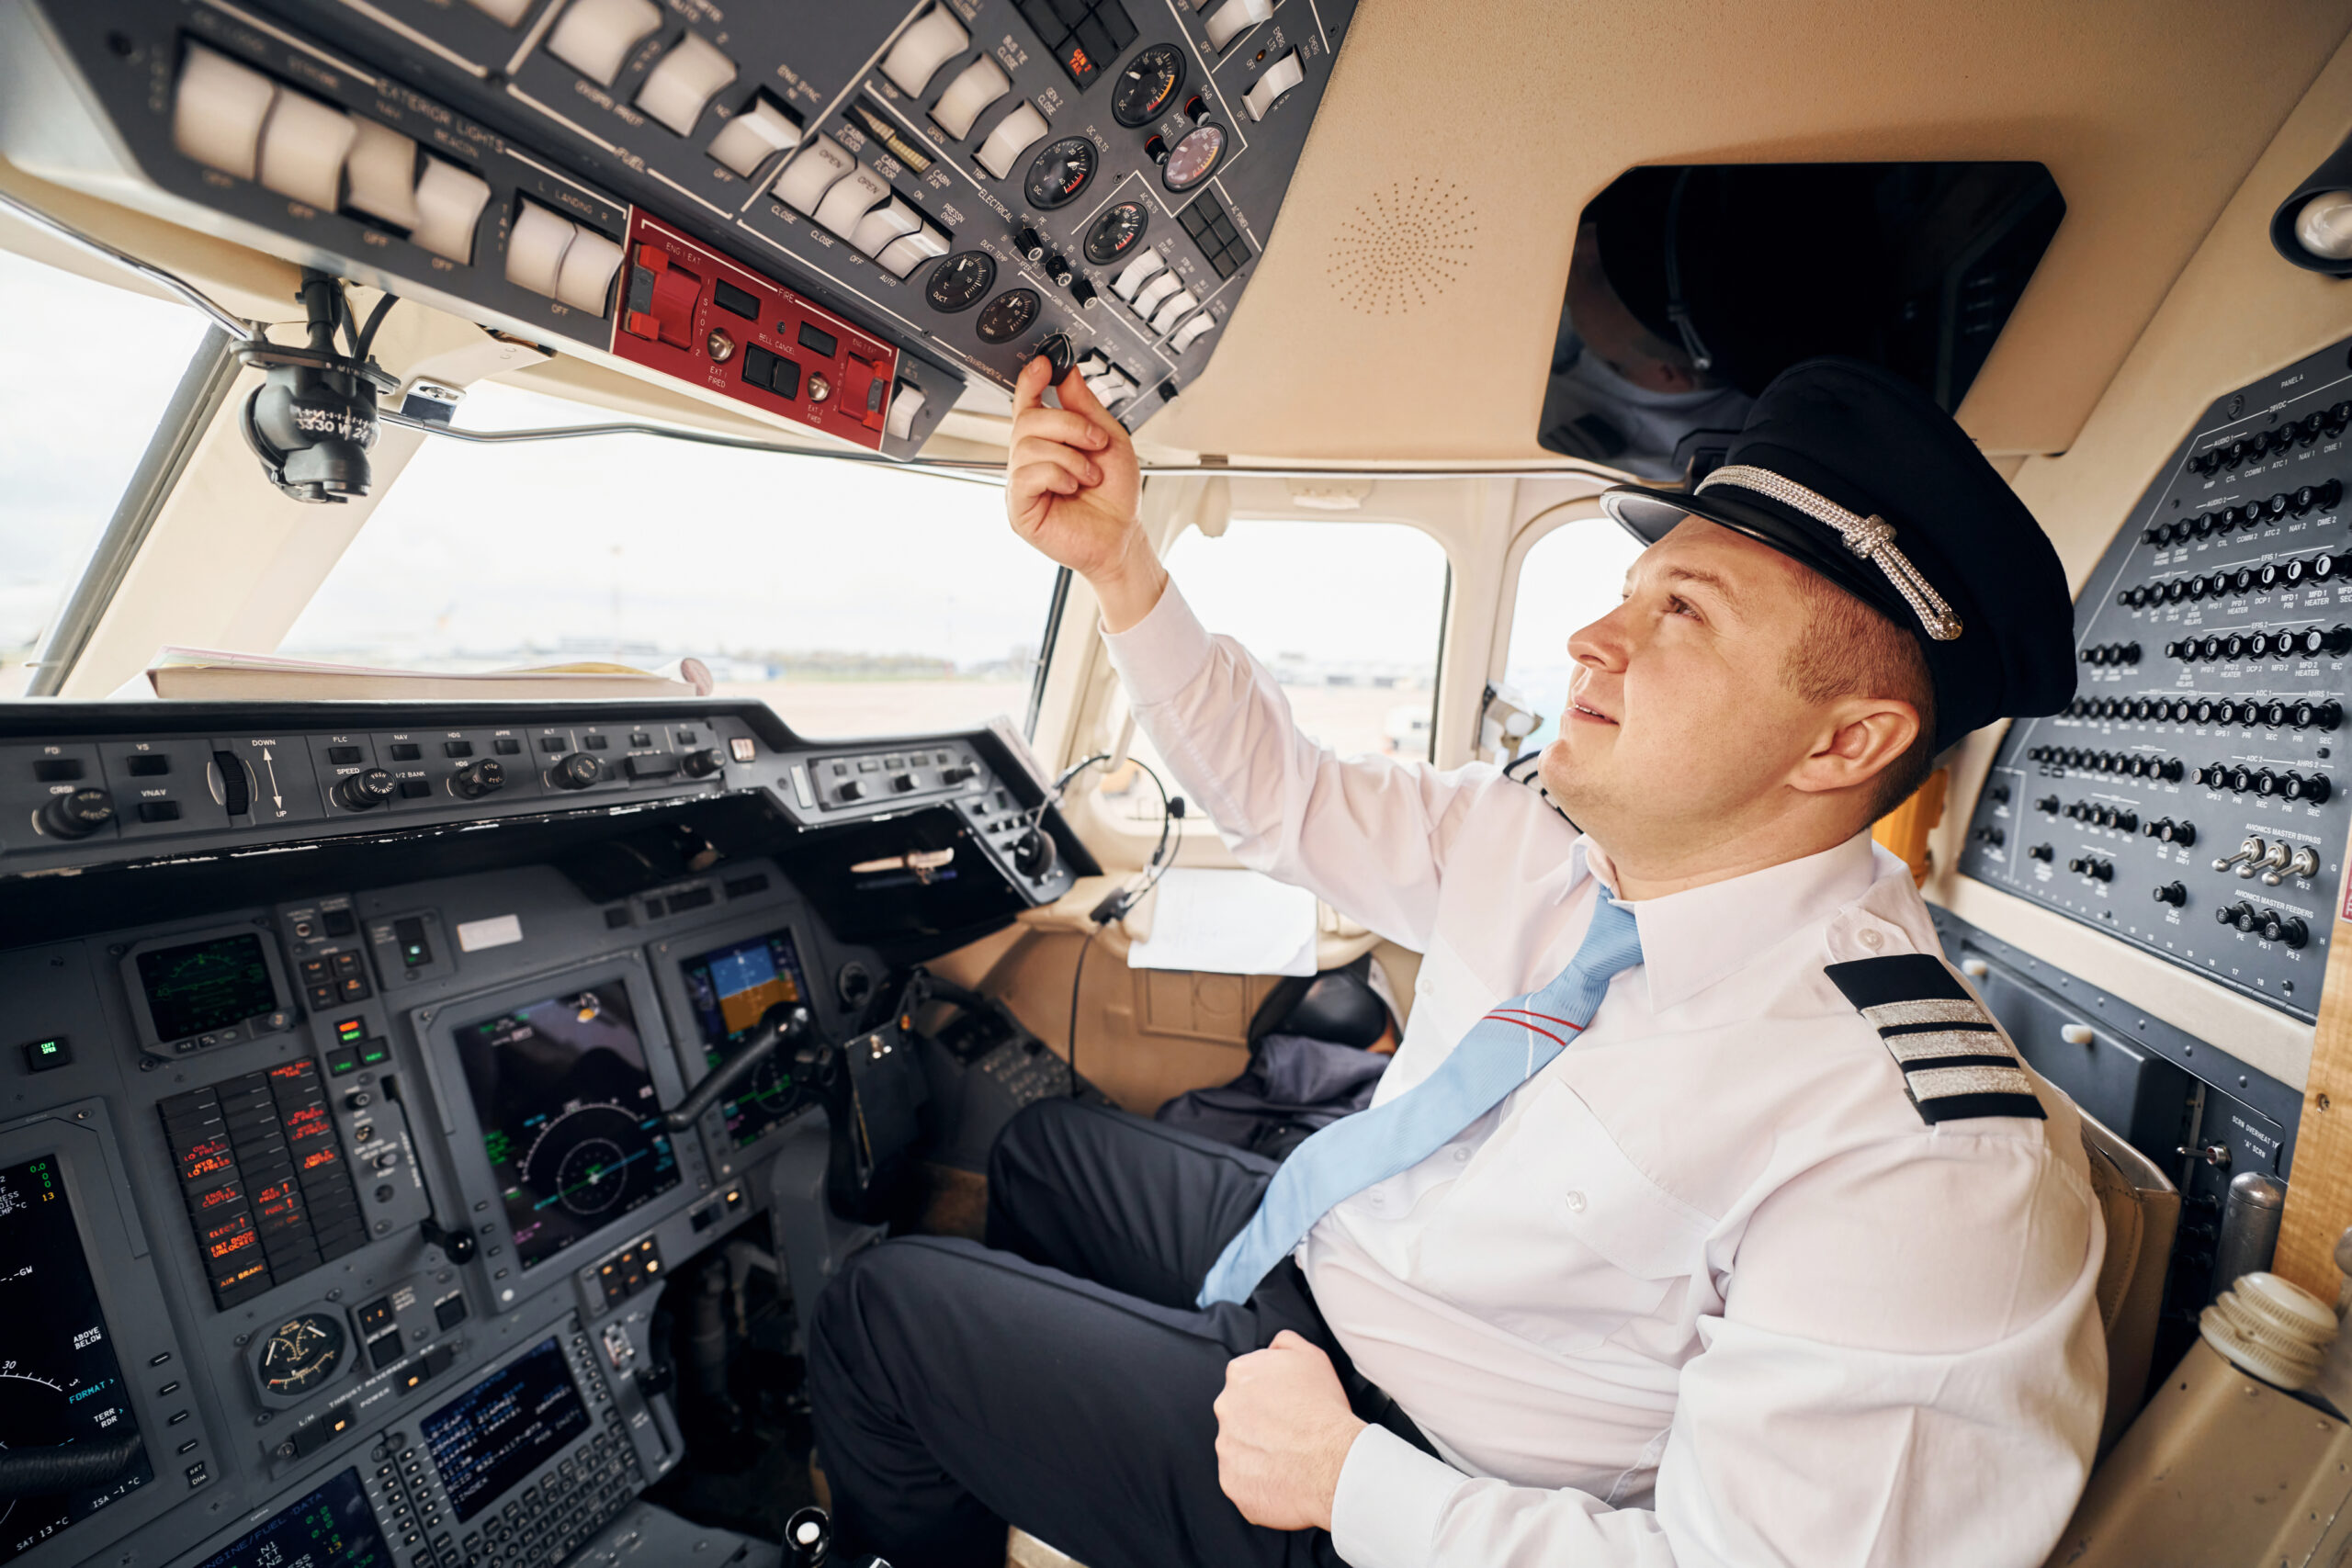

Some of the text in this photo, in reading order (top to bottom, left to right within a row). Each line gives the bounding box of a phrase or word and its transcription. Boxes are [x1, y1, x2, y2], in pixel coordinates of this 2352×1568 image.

[1201, 40, 1211, 53] OFF
[997, 46, 1018, 72] CLOSE
[1246, 59, 1256, 71] OFF
[796, 81, 821, 104] SYNC
[881, 84, 899, 100] TRIP
[1046, 87, 1059, 101] GEN
[1037, 95, 1056, 116] CLOSE
[377, 80, 505, 153] EXTERIOR LIGHTS
[1172, 113, 1185, 128] AMPS
[843, 123, 865, 146] CABIN
[927, 127, 944, 144] OPEN
[1086, 125, 1109, 152] DC VOLTS
[1160, 124, 1173, 139] BATT
[434, 130, 479, 158] BEACON
[615, 147, 646, 173] FUEL
[819, 149, 842, 169] OPEN
[881, 153, 902, 173] CABIN
[713, 169, 733, 183] OFF
[874, 160, 897, 179] FLOOR
[973, 167, 986, 181] TRIP
[857, 176, 877, 194] OPEN
[926, 176, 941, 189] FAN
[933, 170, 951, 187] CABIN
[914, 190, 924, 200] ON
[1034, 185, 1042, 195] DC
[555, 190, 593, 214] LANDING
[978, 188, 1012, 223] ELECTRICAL
[771, 205, 797, 224] CLOSE
[941, 212, 956, 226] OVRD
[943, 203, 965, 223] PRESSN
[364, 231, 389, 248] OFF
[810, 230, 834, 248] CLOSE
[666, 242, 701, 265] ENG EXT
[980, 240, 1008, 262] DUCT TEMP
[432, 257, 454, 272] OFF
[850, 254, 864, 265] OFF
[1019, 261, 1032, 272] XFER
[880, 274, 896, 288] AUTO
[777, 288, 794, 303] FIRE
[933, 291, 947, 303] DUCT
[551, 304, 570, 316] OFF
[758, 333, 796, 355] BELL CANCEL
[710, 367, 723, 377] EXT
[707, 376, 726, 388] FIRED
[2281, 378, 2299, 389] PANEL
[808, 405, 818, 413] EXT
[2269, 400, 2287, 412] 28VDC
[807, 413, 821, 424] FIRED
[2214, 436, 2229, 446] AUDIO
[2324, 444, 2338, 453] DME
[2299, 452, 2311, 460] NAV
[2245, 468, 2261, 477] COMM
[2290, 524, 2301, 532] NAV
[2317, 517, 2331, 526] DME
[2237, 535, 2252, 543] COMM
[2305, 597, 2329, 606] HEATER
[141, 789, 166, 797] VNAV
[2245, 823, 2321, 844] AVIONICS MASTER BYPASS
[2235, 889, 2313, 919] AVIONICS MASTER FEEDERS
[2242, 919, 2249, 927] 35
[2268, 927, 2276, 936] 35
[2287, 950, 2294, 958] PS
[301, 1110, 323, 1122] PRESS
[305, 1123, 329, 1135] PRESS
[2233, 1115, 2245, 1129] SCRN
[2245, 1124, 2270, 1145] OVERHEAT
[185, 1143, 226, 1161] LO PRESS
[2253, 1145, 2266, 1158] SCRN
[30, 1163, 46, 1173] 0.0
[187, 1158, 230, 1178] LO PRESS
[195, 1158, 213, 1169] HYD
[42, 1192, 54, 1201] 13
[266, 1203, 284, 1215] FUEL
[209, 1223, 235, 1238] ELECT
[211, 1231, 254, 1253] ENT DOOR
[213, 1235, 255, 1258] UNLOCKED
[220, 1265, 263, 1287] AIR BRAKE
[74, 1326, 99, 1343] ABOVE
[75, 1334, 101, 1350] BELOW
[2, 1360, 17, 1369] 30
[329, 1359, 409, 1407] THRUST REVERSER
[69, 1381, 106, 1404] FORMAT
[360, 1387, 390, 1408] POWER
[94, 1407, 115, 1422] TERR
[101, 1416, 118, 1428] RDR
[189, 1463, 203, 1475] BRT
[192, 1472, 207, 1485] DIM
[93, 1485, 125, 1508] ISA -1
[292, 1493, 322, 1515] DATA
[17, 1526, 53, 1551] SAT 13
[261, 1541, 278, 1554] N1
[328, 1541, 342, 1554] 13
